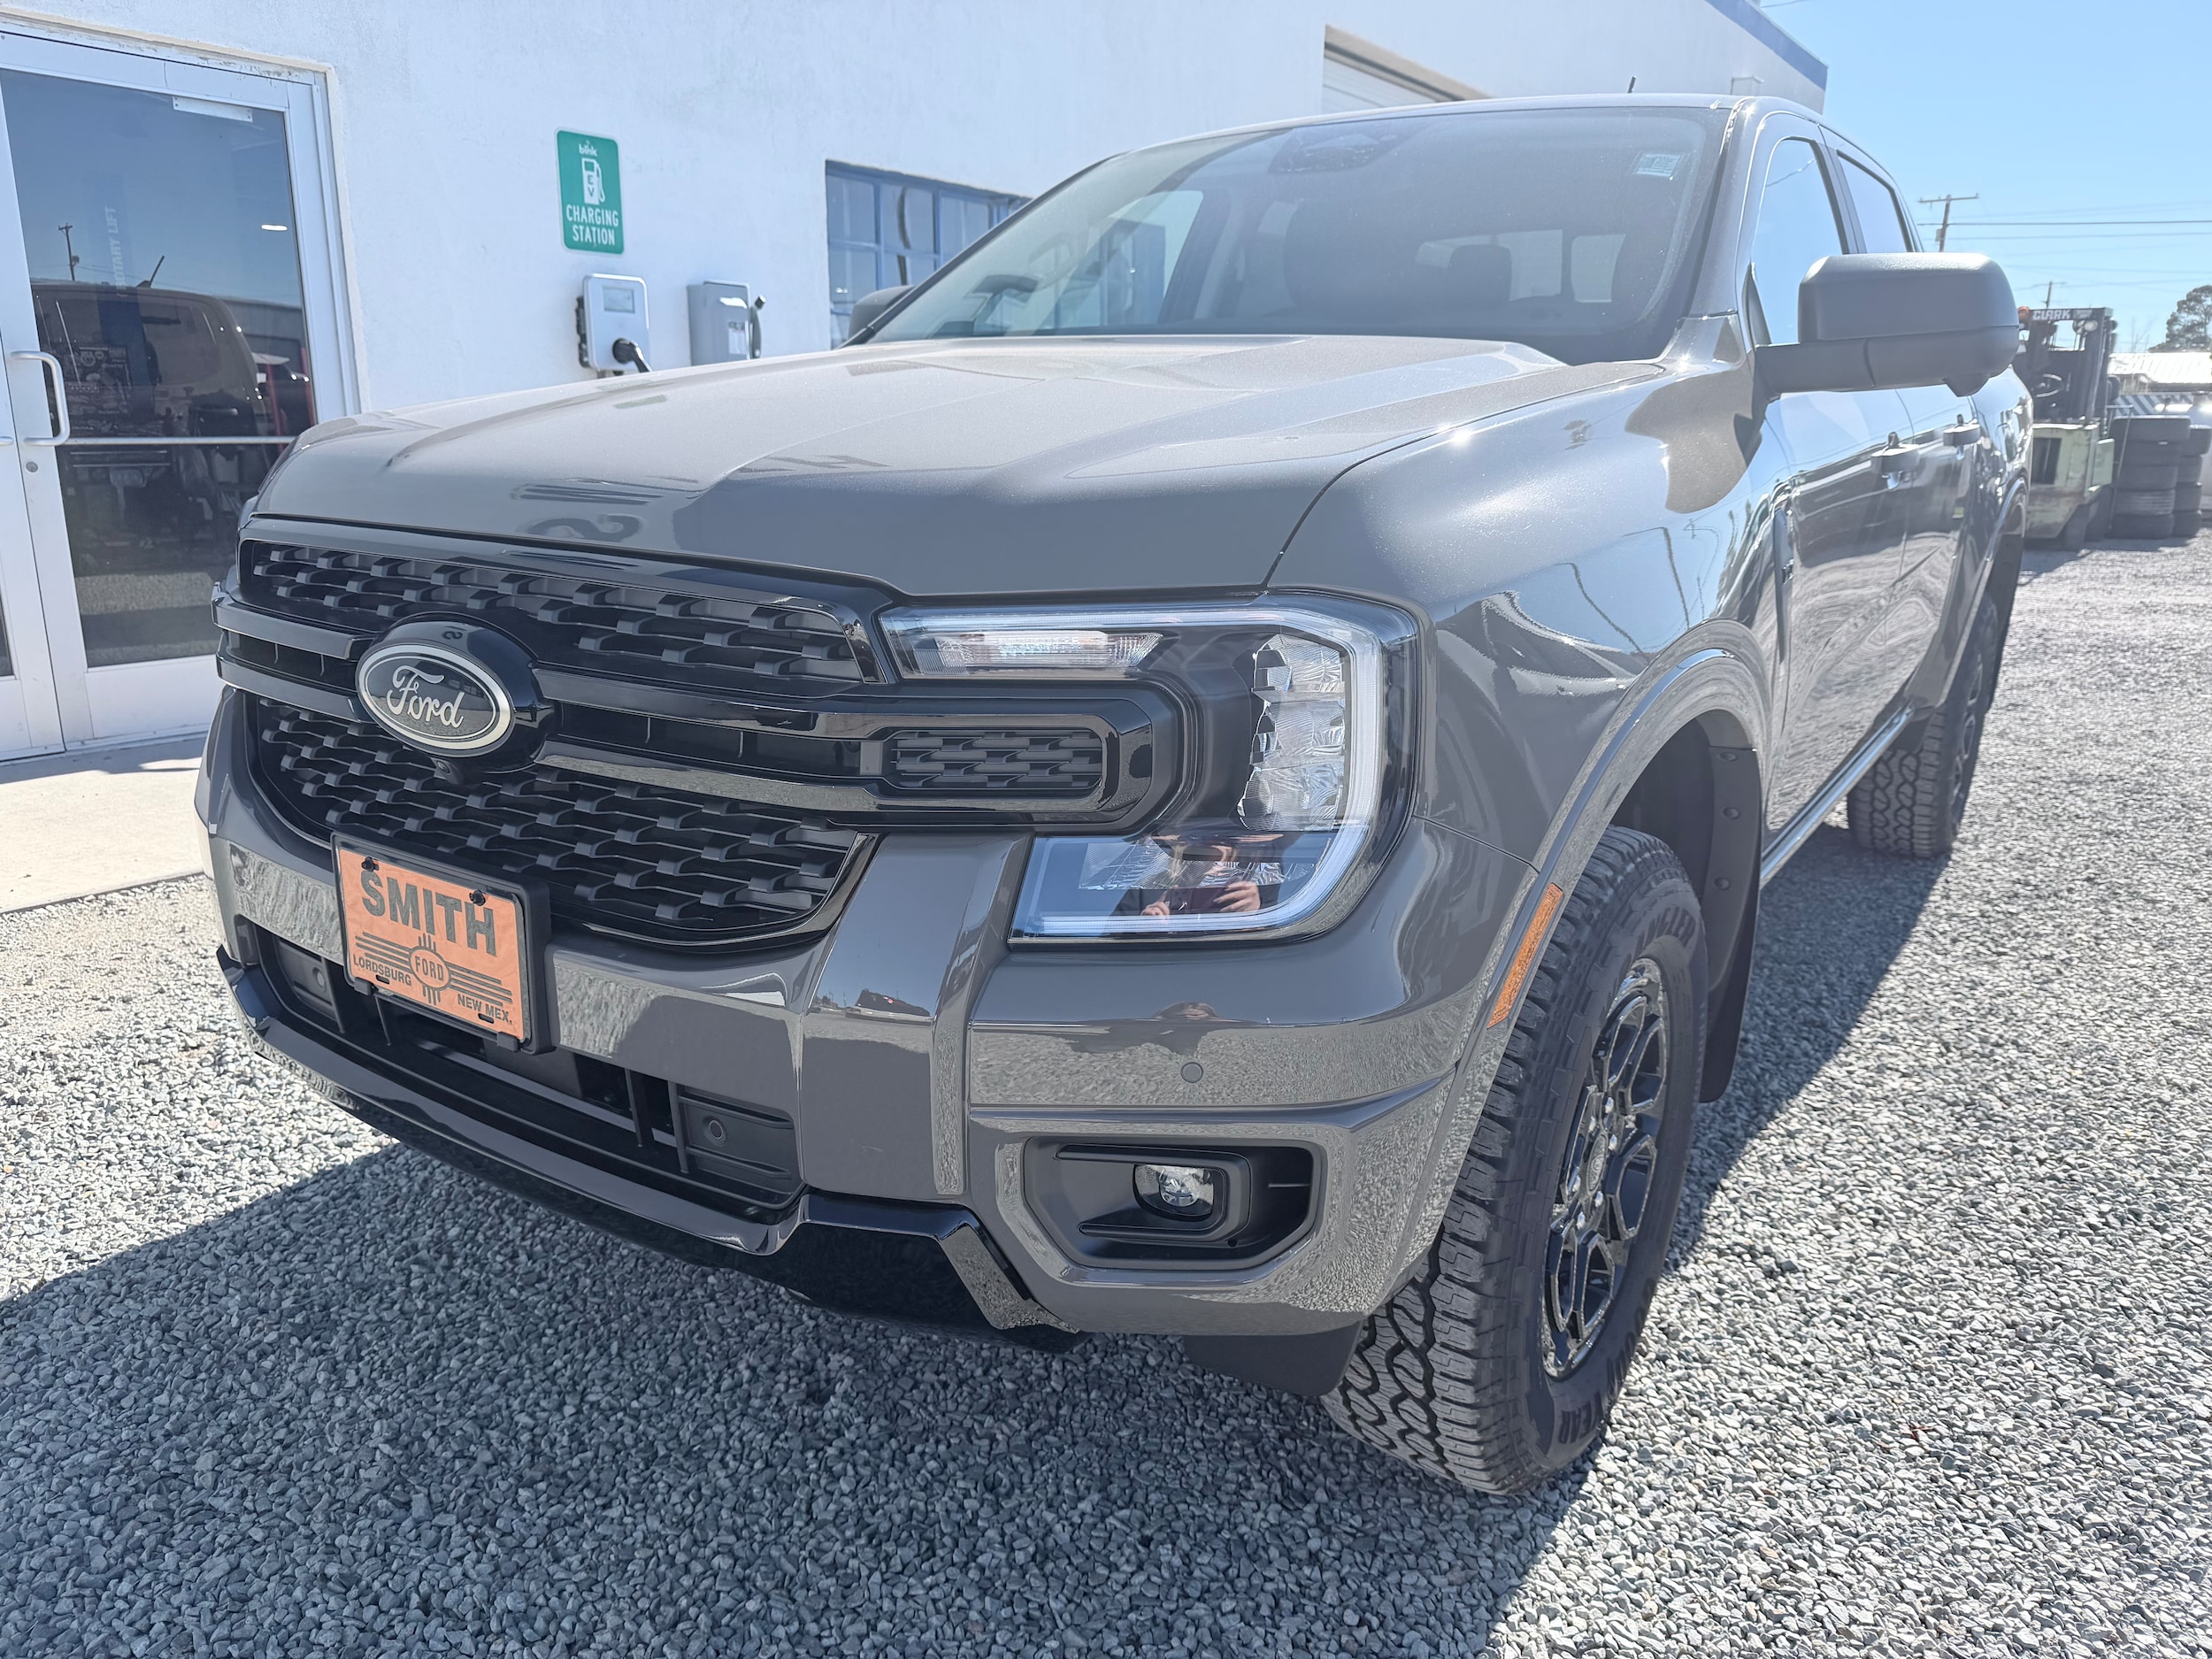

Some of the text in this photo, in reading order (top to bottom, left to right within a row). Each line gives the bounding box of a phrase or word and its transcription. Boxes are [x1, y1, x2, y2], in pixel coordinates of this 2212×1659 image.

[579, 142, 598, 157] blink
[105, 204, 119, 234] LIFT
[566, 204, 619, 227] CHARGING
[572, 225, 616, 246] STATION
[2032, 309, 2071, 320] CLARK
[386, 664, 465, 729] Ford
[360, 869, 497, 958] SMITH
[352, 954, 413, 987] LORDSBURG
[414, 955, 445, 982] FORD
[457, 993, 513, 1025] NEW MEX.
